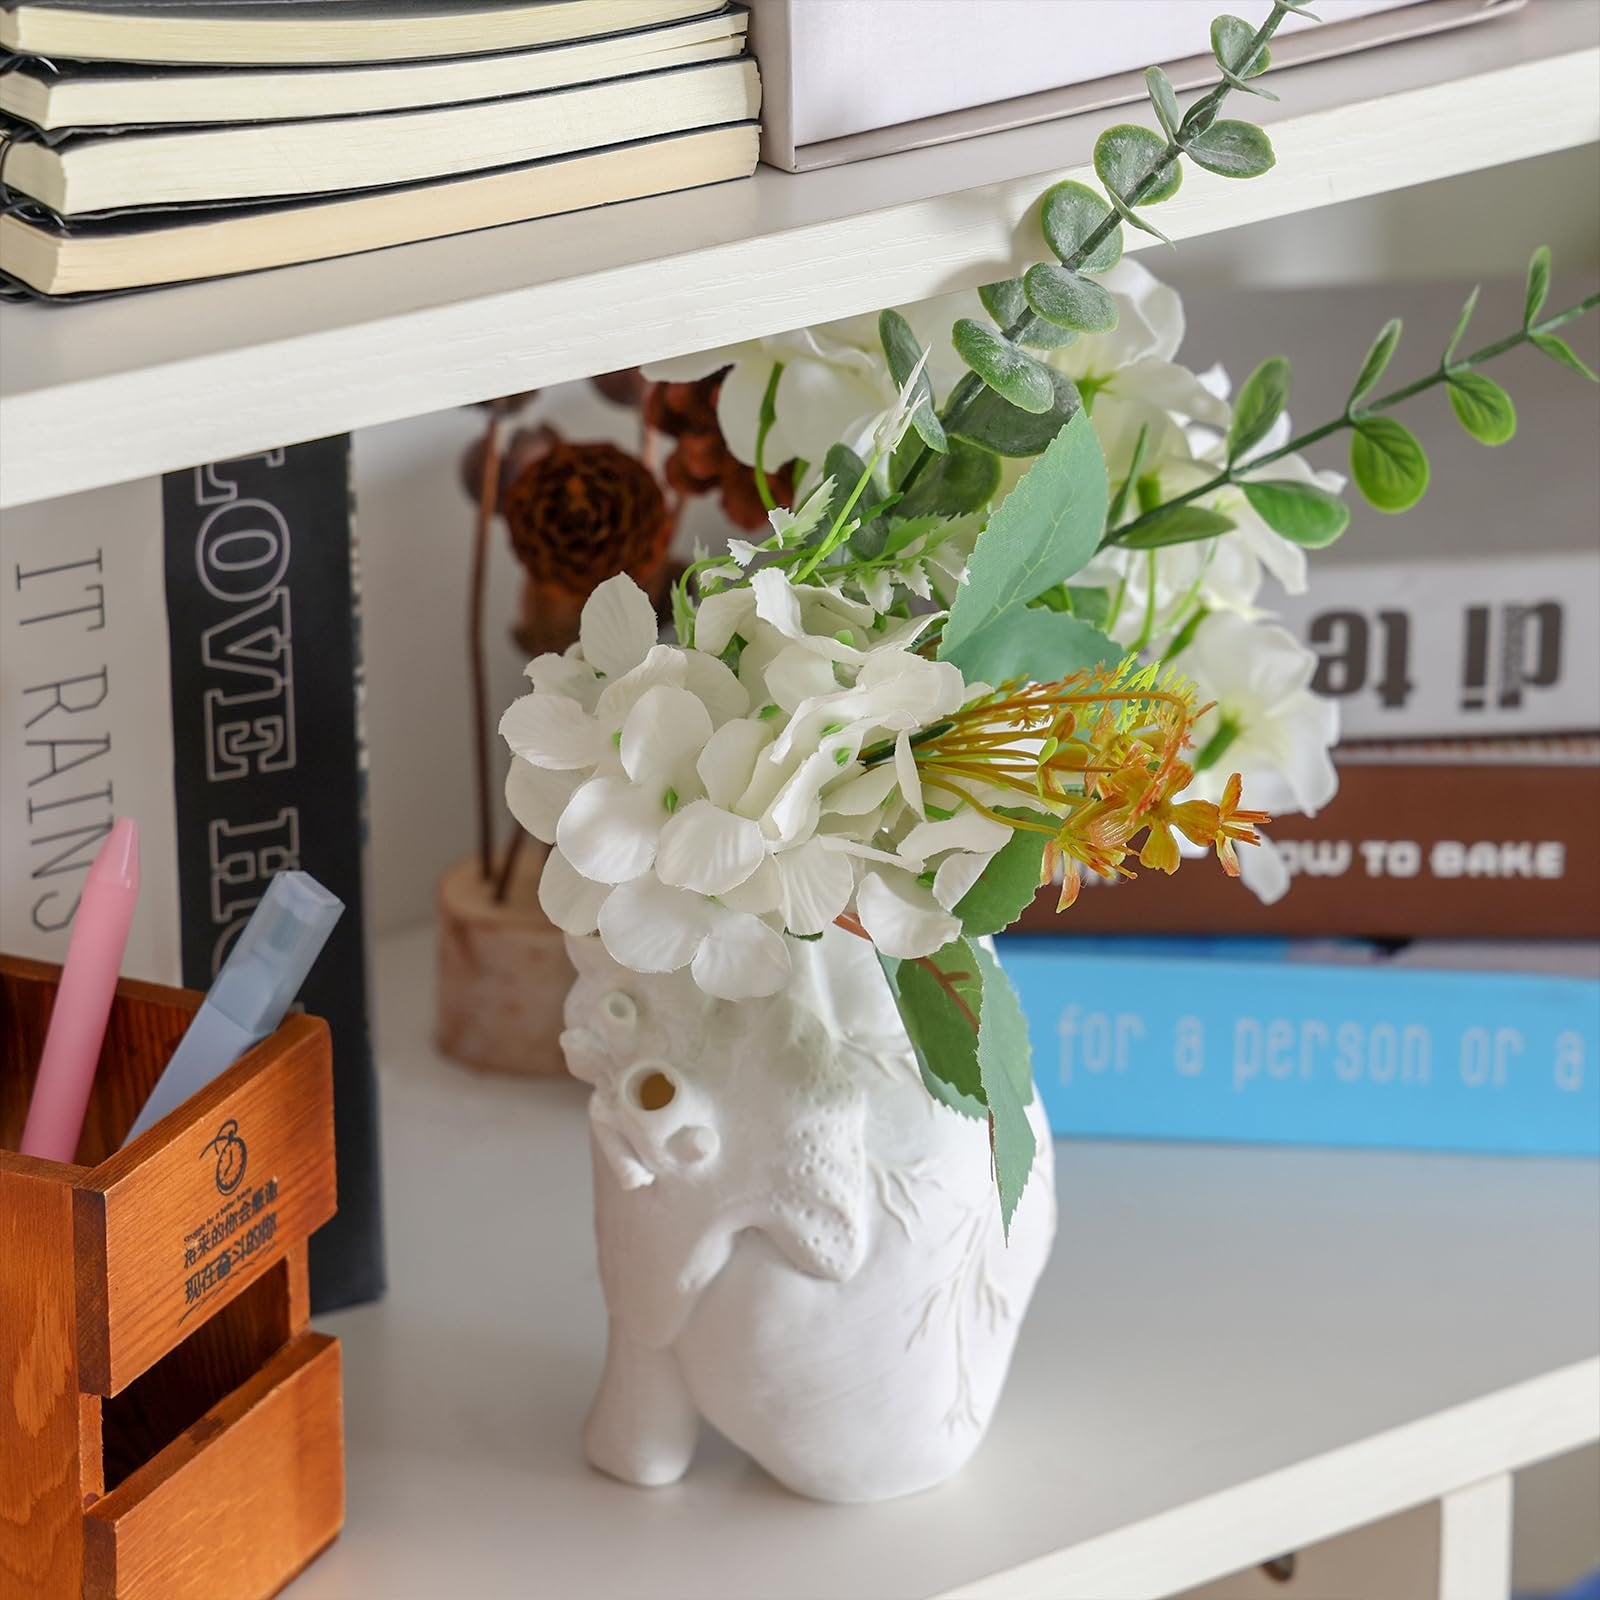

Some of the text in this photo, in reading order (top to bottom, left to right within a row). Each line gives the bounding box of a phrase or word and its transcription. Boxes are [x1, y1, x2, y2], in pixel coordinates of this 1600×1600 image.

[194, 446, 297, 782] LOVE
[16, 547, 115, 934] IT RAINS
[1358, 840, 1424, 877] TO
[1429, 840, 1566, 878] BAKE
[1054, 1001, 1586, 1094] for a person or a
